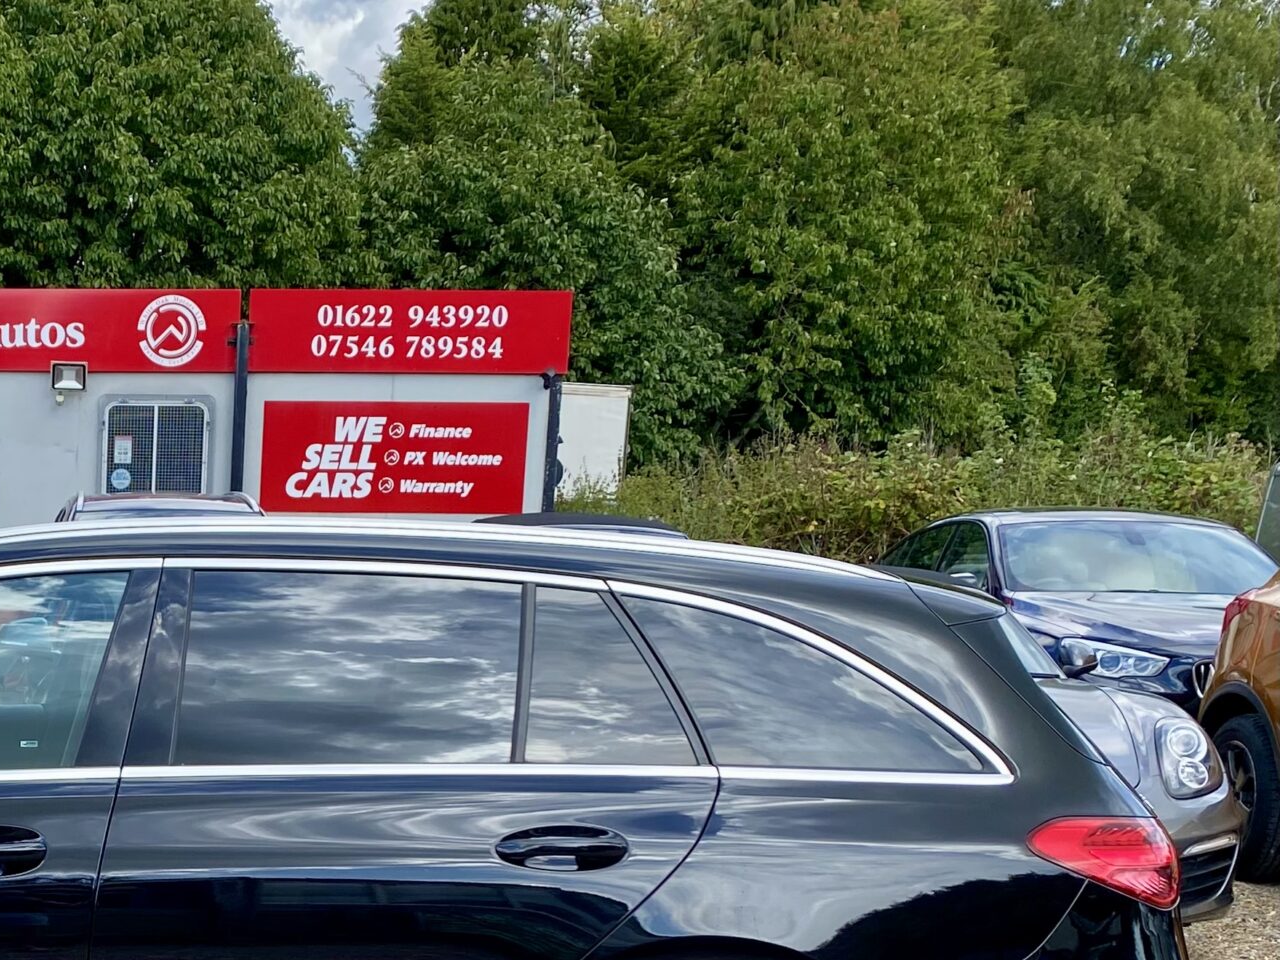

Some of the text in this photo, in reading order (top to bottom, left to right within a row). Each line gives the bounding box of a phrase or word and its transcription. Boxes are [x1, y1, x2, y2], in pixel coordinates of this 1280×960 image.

[317, 304, 509, 328] 01622 943920
[311, 334, 504, 359] 07546 789584
[334, 416, 387, 443] WE
[409, 423, 472, 439] Finance
[301, 443, 377, 470] SELL
[403, 451, 503, 466] PX Welcome
[285, 472, 374, 499] CARS
[399, 479, 474, 498] Warranty
